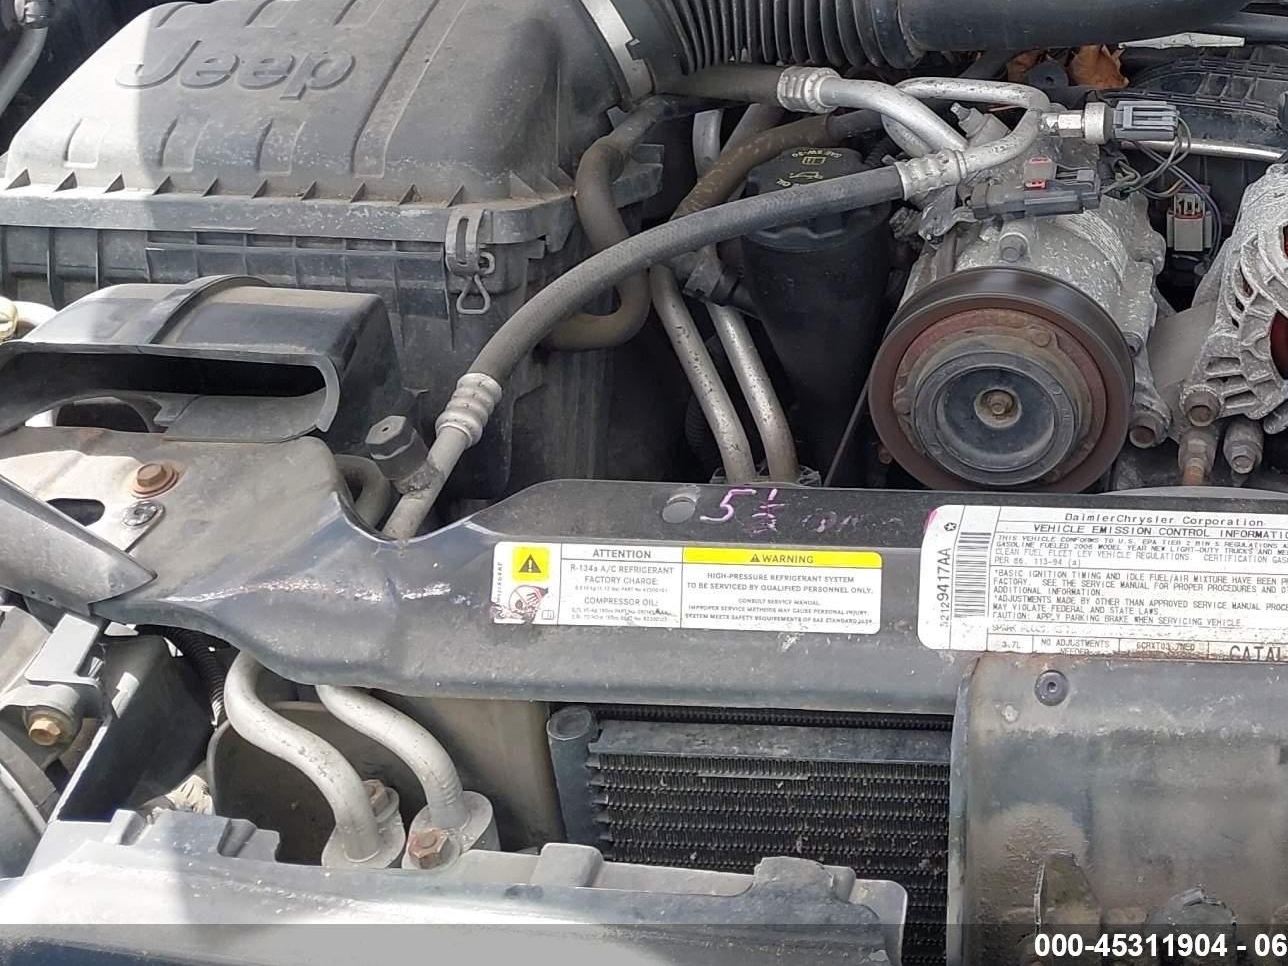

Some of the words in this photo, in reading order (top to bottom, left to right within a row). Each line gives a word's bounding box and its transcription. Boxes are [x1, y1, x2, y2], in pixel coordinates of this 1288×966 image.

[115, 40, 355, 101] Jeep
[700, 488, 756, 522] 5
[1065, 513, 1174, 525] DaimlerChrysler
[1182, 516, 1264, 527] Corporation
[1033, 524, 1085, 534] VEHICLE
[1092, 526, 1152, 536] EMISSION
[1159, 528, 1211, 538] CONTROL
[1170, 546, 1219, 554] LIGHT-DUTY
[1225, 547, 1254, 555] TRUCKS
[1224, 541, 1278, 549] REGULATIONS
[592, 548, 652, 559] ATTENTION
[762, 554, 814, 564] WARNING
[1097, 551, 1132, 559] VEHICLE
[1203, 553, 1268, 563] CERTIFICATION
[1034, 557, 1063, 566] 113-94
[570, 564, 598, 573] R-134a
[600, 564, 617, 574] A/C
[618, 565, 675, 575] REFRIGERANT
[584, 576, 621, 585] FACTORY
[623, 577, 659, 586] CHARGE:
[707, 572, 768, 581] HIGH-PRESSURE
[770, 574, 823, 583] REFRIGERANT
[1029, 570, 1067, 579] IGNITION
[1071, 570, 1102, 580] TIMING
[1105, 572, 1121, 581] AND
[1126, 573, 1145, 581] IDLE
[1149, 573, 1189, 583] FUEL/AIR
[1193, 575, 1228, 584] MIXTURE
[1232, 576, 1252, 585] HAVE
[1256, 577, 1277, 586] BEEN
[687, 582, 697, 590] TO
[710, 583, 748, 591] SERVICED
[803, 586, 849, 594] PERSONNEL
[850, 586, 874, 595] ONLY.
[993, 587, 1041, 595] ADDITIONAL
[1042, 579, 1057, 587] SEE
[1062, 579, 1079, 587] THE
[1081, 579, 1116, 588] SERVICE
[1120, 580, 1150, 590] MANUAL
[1154, 581, 1169, 590] FOR
[1173, 583, 1204, 592] PROPER
[1207, 584, 1257, 593] PROCEDURES
[1261, 585, 1277, 594] AND
[584, 597, 641, 606] COMPRESSOR
[643, 598, 659, 607] OIL:
[1056, 595, 1077, 604] MADE
[1080, 596, 1091, 604] BY
[1095, 597, 1120, 606] OTHER
[1125, 598, 1145, 607] THAN
[1149, 599, 1188, 608] APPROVED
[1192, 600, 1227, 610] SERVICE
[1232, 602, 1261, 611] MANUAL
[992, 603, 1008, 611] MAY
[1012, 603, 1046, 612] VIOLATE
[1051, 604, 1085, 613] FEDERAL
[1089, 605, 1105, 614] AND
[1109, 606, 1134, 614] STATE
[754, 615, 802, 623] REQUIREMENTS
[1036, 612, 1061, 621] APPLY
[1065, 613, 1100, 623] PARKING
[1104, 615, 1129, 623] BRAKE
[1134, 615, 1154, 624] WHEN
[1158, 616, 1203, 626] SERVICING
[1207, 618, 1241, 627] VEHICLE
[1001, 641, 1021, 649] 3.7L
[1041, 638, 1051, 646] NO
[1055, 639, 1111, 647] ADJUSTMENTS
